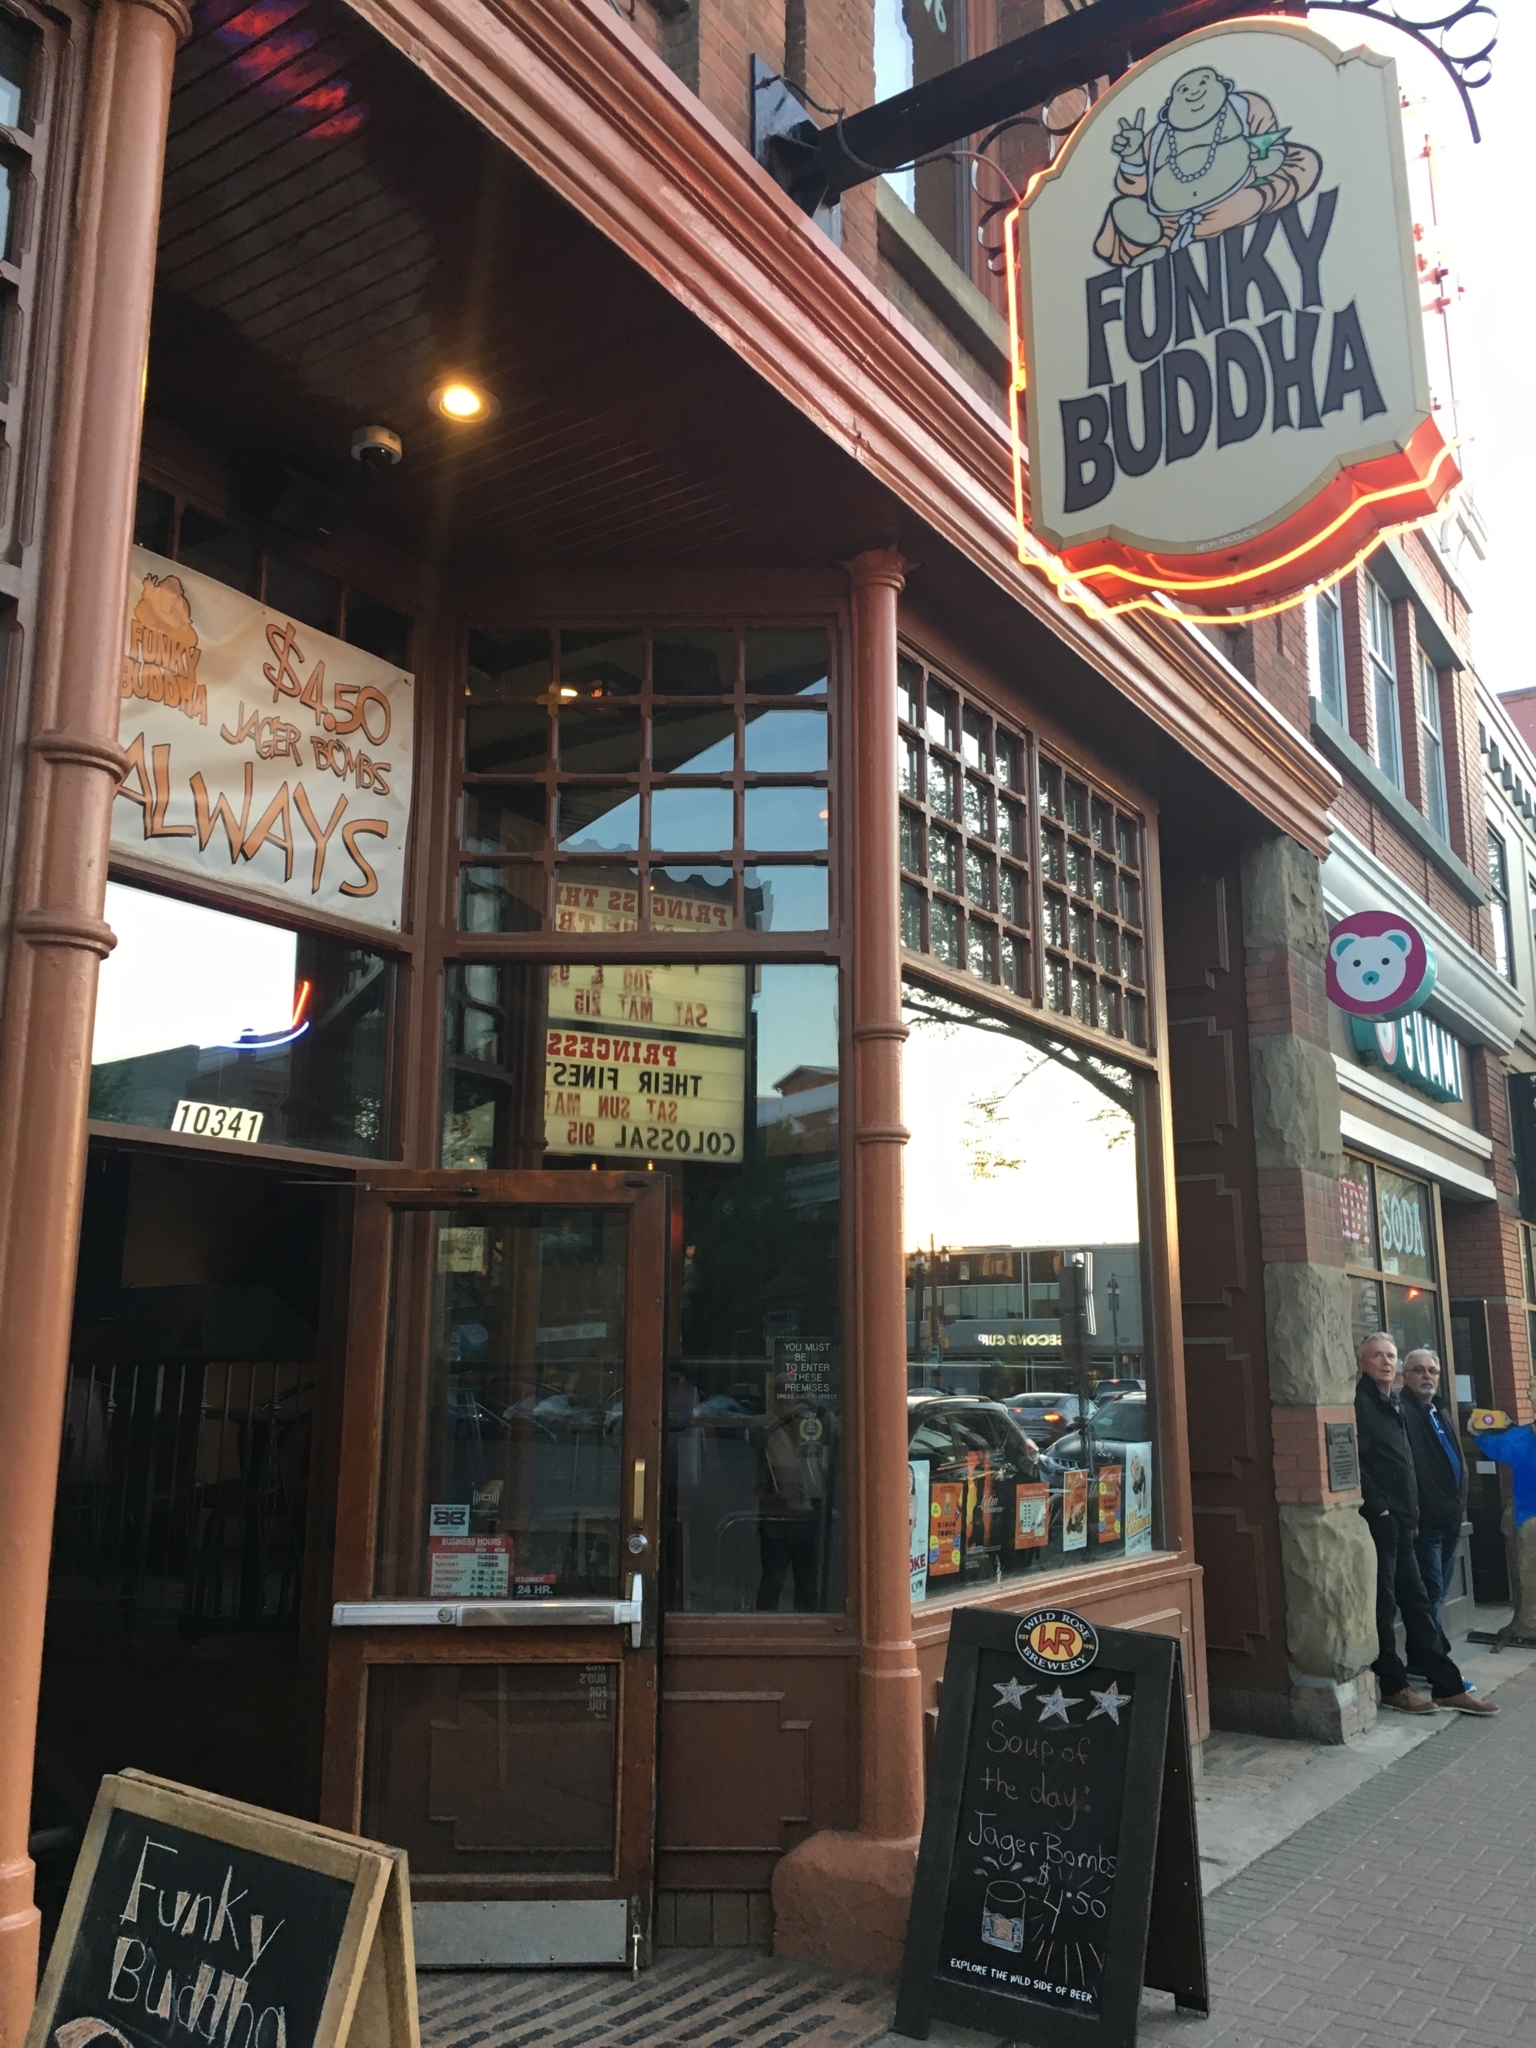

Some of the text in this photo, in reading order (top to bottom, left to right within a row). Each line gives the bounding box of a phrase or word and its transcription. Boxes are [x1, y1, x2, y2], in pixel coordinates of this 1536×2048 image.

[1085, 184, 1339, 389] FUNKY
[1059, 300, 1388, 514] BUDDHA
[1196, 528, 1258, 552] NEON PRODUCTS
[130, 618, 202, 680] FUNKY
[120, 654, 208, 726] BUDDHA
[263, 622, 391, 746] $4.50
[220, 701, 391, 796] JAGER BOMBS
[113, 732, 389, 898] ALWAYS
[179, 1104, 258, 1141] 10341
[1381, 1191, 1426, 1259] SODA
[784, 1343, 830, 1351] YOU MUST
[785, 1363, 830, 1371] TO ENTER
[794, 1353, 806, 1362] BE
[784, 1383, 829, 1392] PREMISES
[793, 1373, 822, 1381] THESE
[441, 1537, 502, 1546] BUSINESS HOURS
[517, 1585, 554, 1594] 24 HR.
[1023, 1612, 1091, 1640] WILD ROSE
[1038, 1624, 1076, 1657] WR
[1022, 1645, 1087, 1671] BREWERY
[986, 1719, 1091, 1765] Soup of
[980, 1767, 1019, 1801] the
[1042, 1831, 1117, 1879] Bombs
[120, 1835, 285, 1983] Funky
[108, 1936, 287, 2048] Buddha
[950, 1957, 988, 1975] EXPLORE
[990, 1967, 1008, 1981] THE
[1055, 1985, 1068, 1996] OF
[1070, 1988, 1093, 2004] BEER
